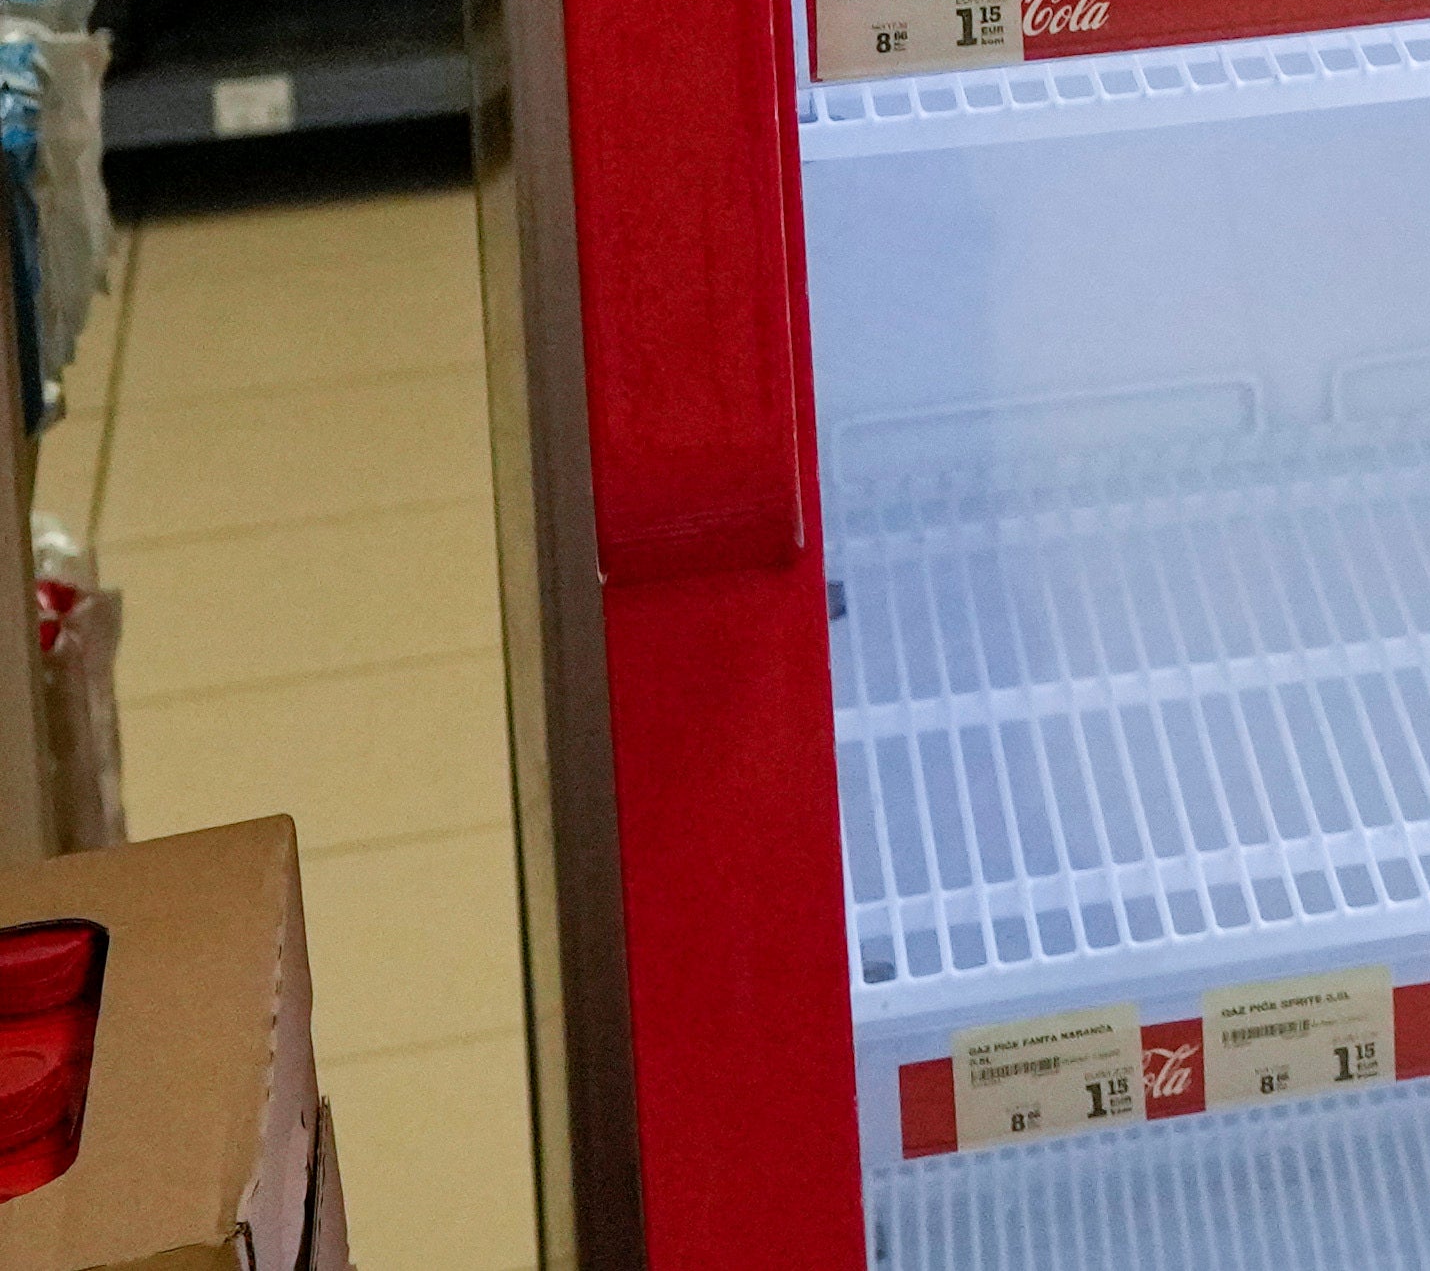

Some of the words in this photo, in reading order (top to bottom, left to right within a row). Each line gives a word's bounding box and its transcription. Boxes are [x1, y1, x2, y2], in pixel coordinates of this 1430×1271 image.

[876, 32, 891, 53] 8
[956, 7, 978, 47] 1
[980, 5, 1002, 24] 15
[1334, 1046, 1355, 1082] 1
[1355, 1041, 1376, 1060] 15
[1086, 1082, 1107, 1119] 1
